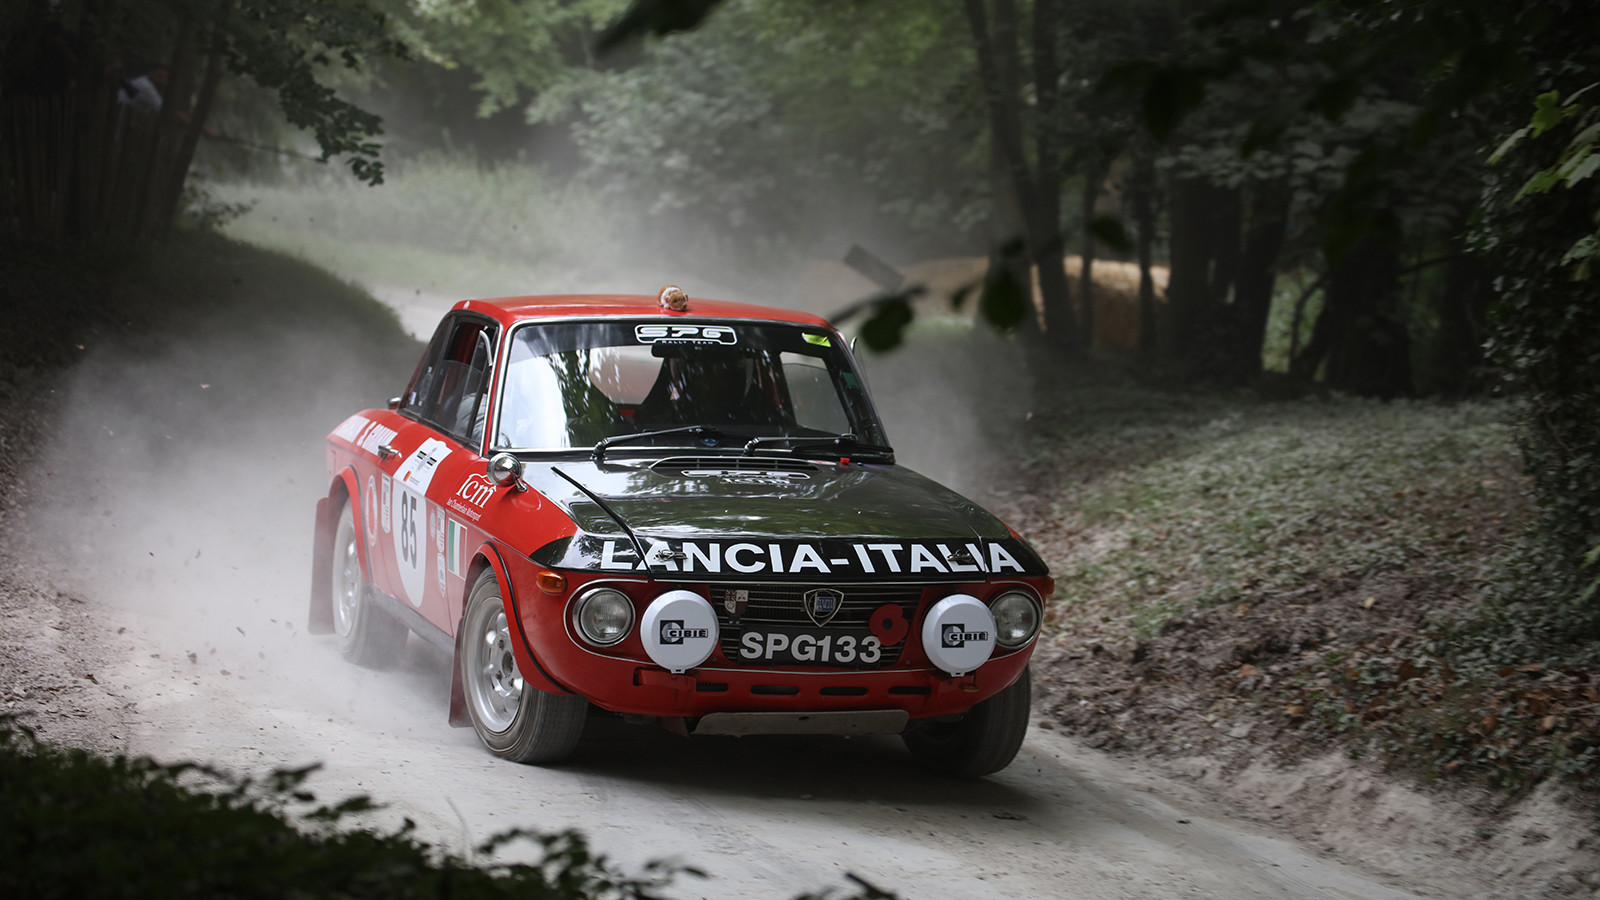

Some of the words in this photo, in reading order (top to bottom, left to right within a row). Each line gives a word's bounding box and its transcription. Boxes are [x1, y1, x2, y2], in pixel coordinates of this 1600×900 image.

[401, 490, 417, 570] 85
[600, 540, 1026, 574] LANCIA-ITALIA
[740, 631, 881, 664] SPG133
